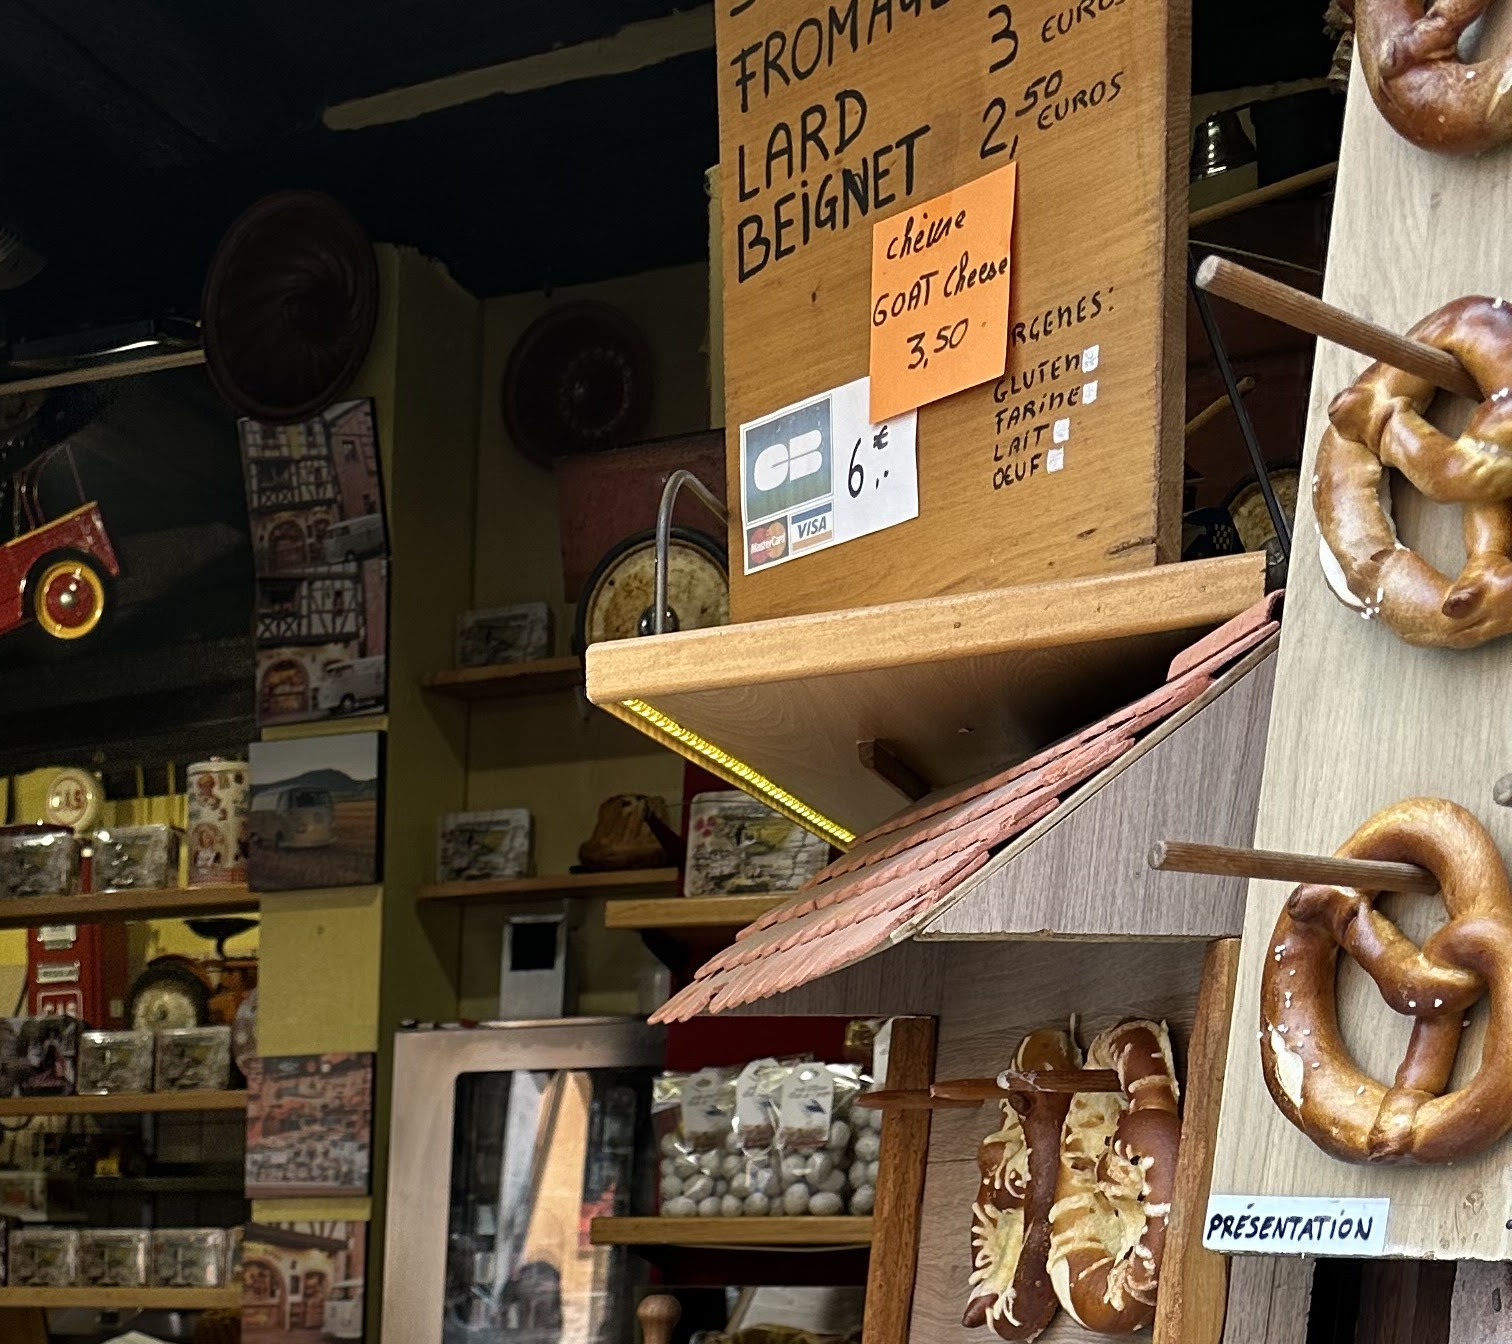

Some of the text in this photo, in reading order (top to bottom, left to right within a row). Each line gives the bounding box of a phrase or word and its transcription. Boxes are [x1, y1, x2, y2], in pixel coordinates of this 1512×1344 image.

[730, 0, 950, 112] FROMA
[738, 89, 868, 203] LARD
[988, 4, 1019, 74] 3
[1037, 71, 1125, 131] EUROS
[872, 269, 940, 327] GOAT
[906, 317, 970, 371] 3,50
[993, 422, 1050, 462] LAIT
[796, 516, 828, 541] VISA
